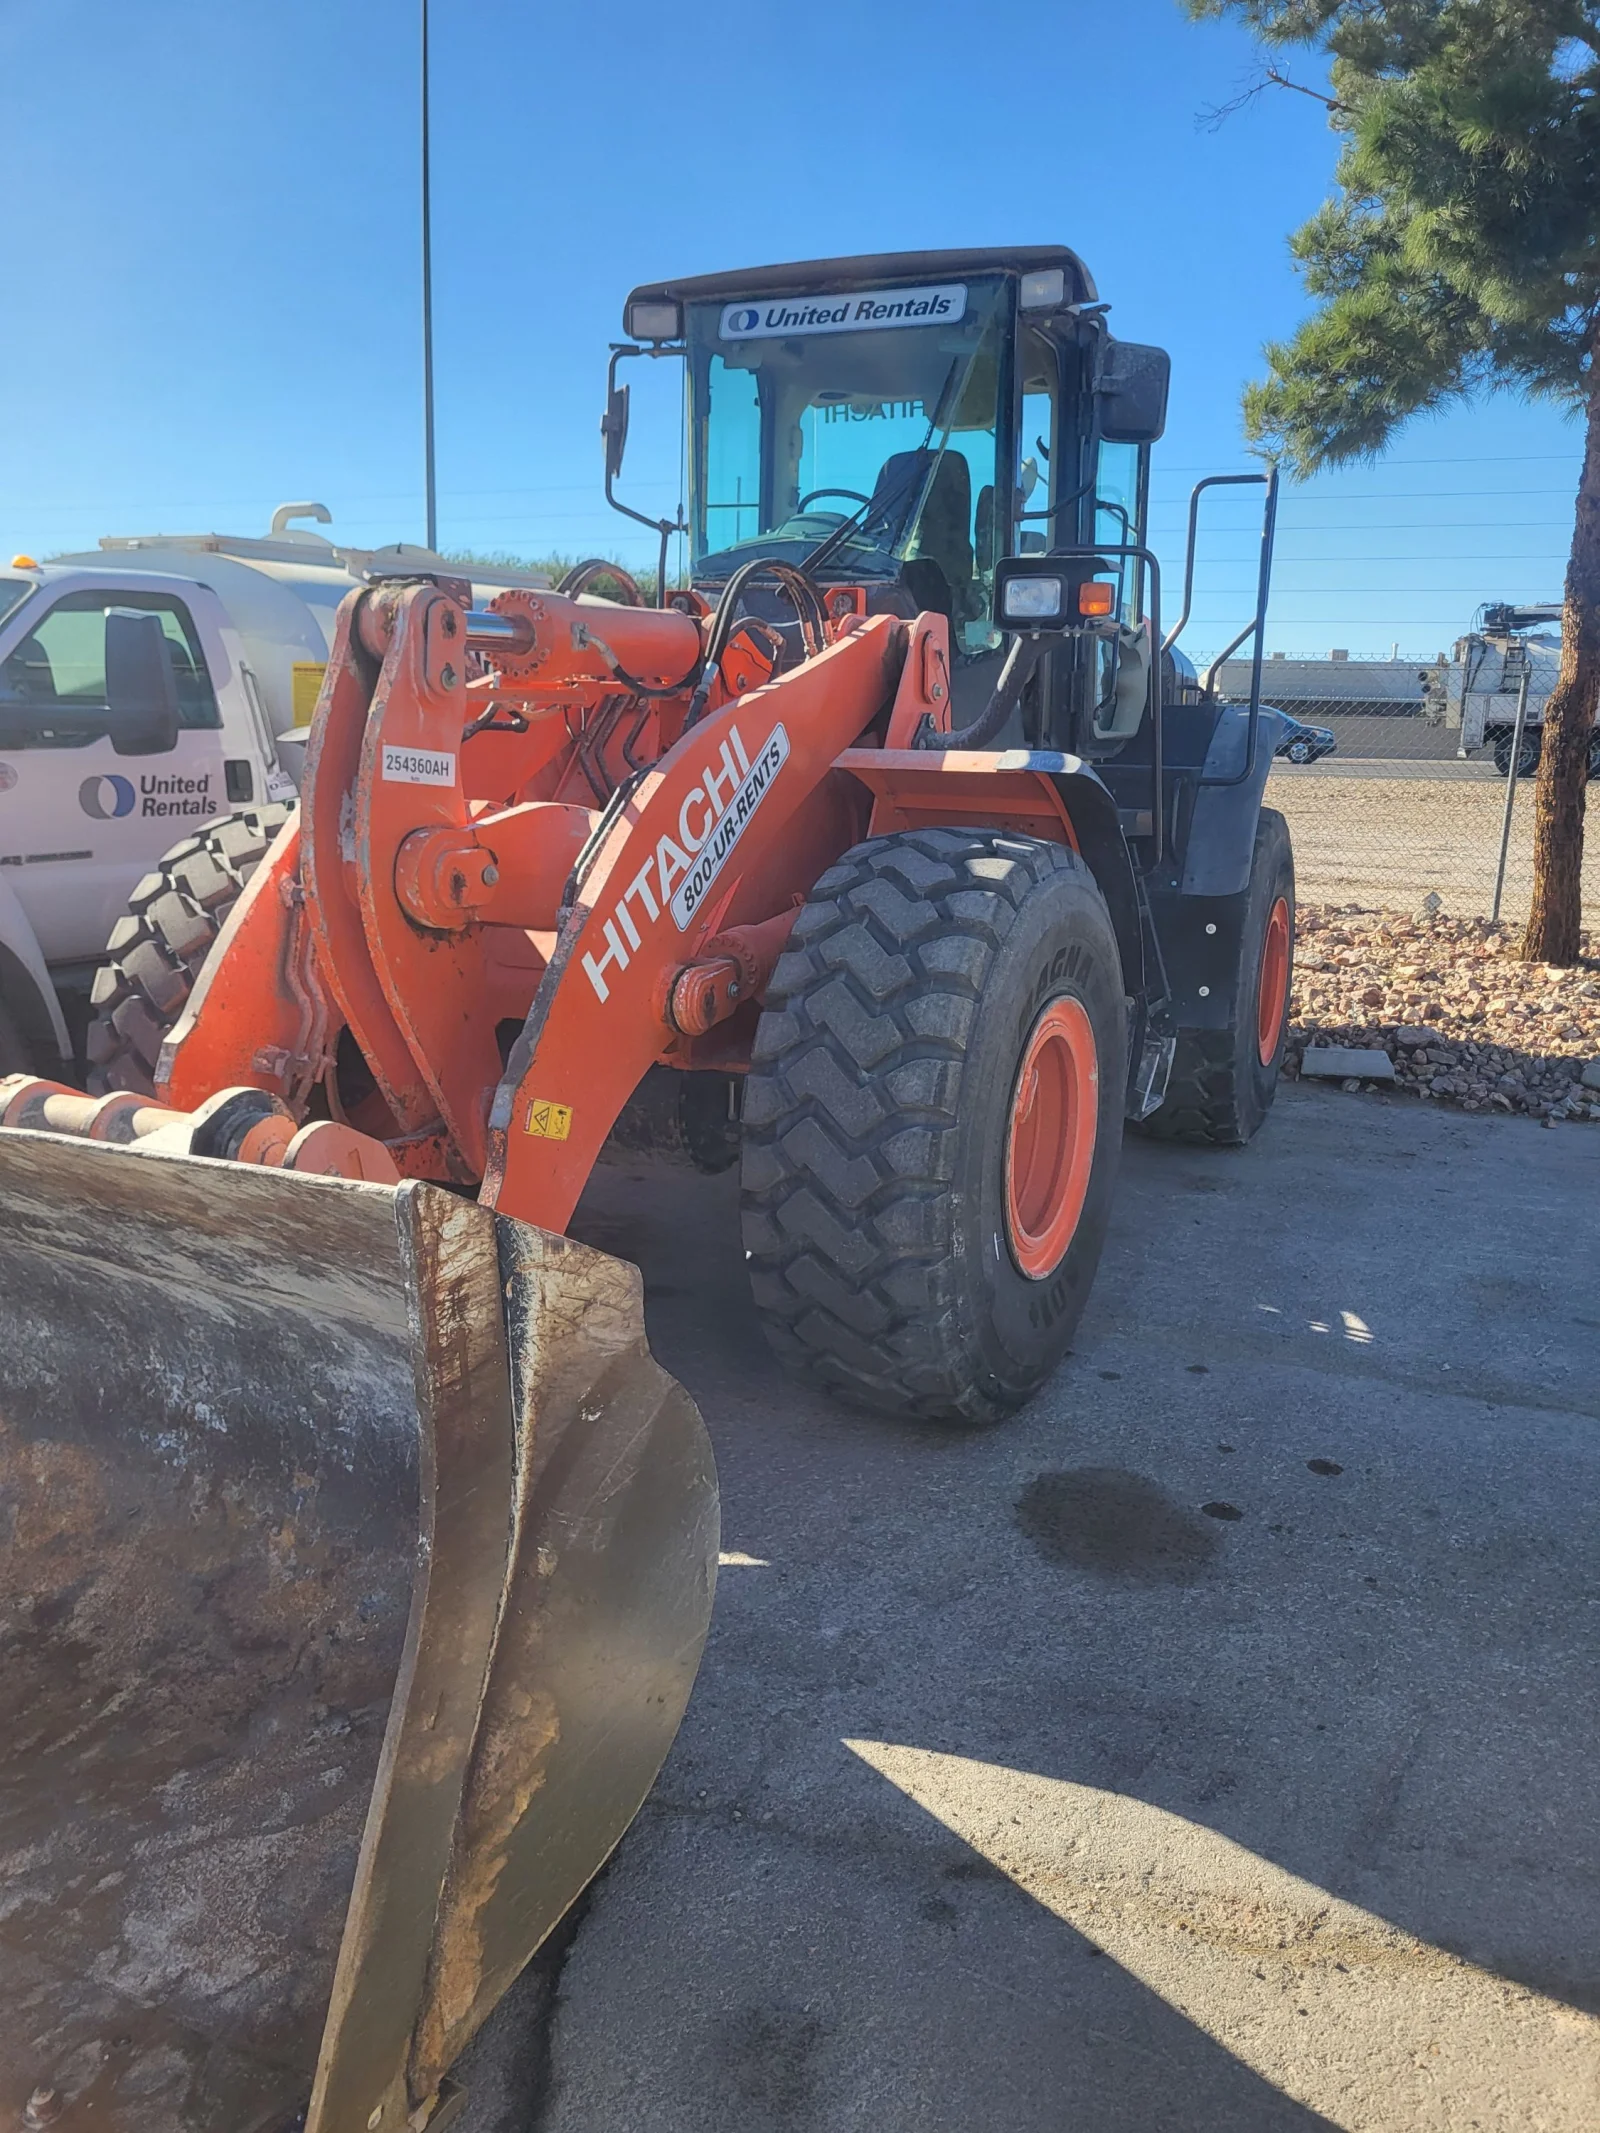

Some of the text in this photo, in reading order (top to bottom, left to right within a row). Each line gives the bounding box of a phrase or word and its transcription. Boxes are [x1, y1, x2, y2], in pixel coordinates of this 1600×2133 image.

[765, 295, 951, 328] United Rentals
[386, 754, 449, 777] 254360AH
[140, 775, 209, 795] United
[141, 798, 217, 817] Rentals
[684, 741, 781, 912] 800-UR-RENTS
[581, 724, 751, 1004] HITACHI
